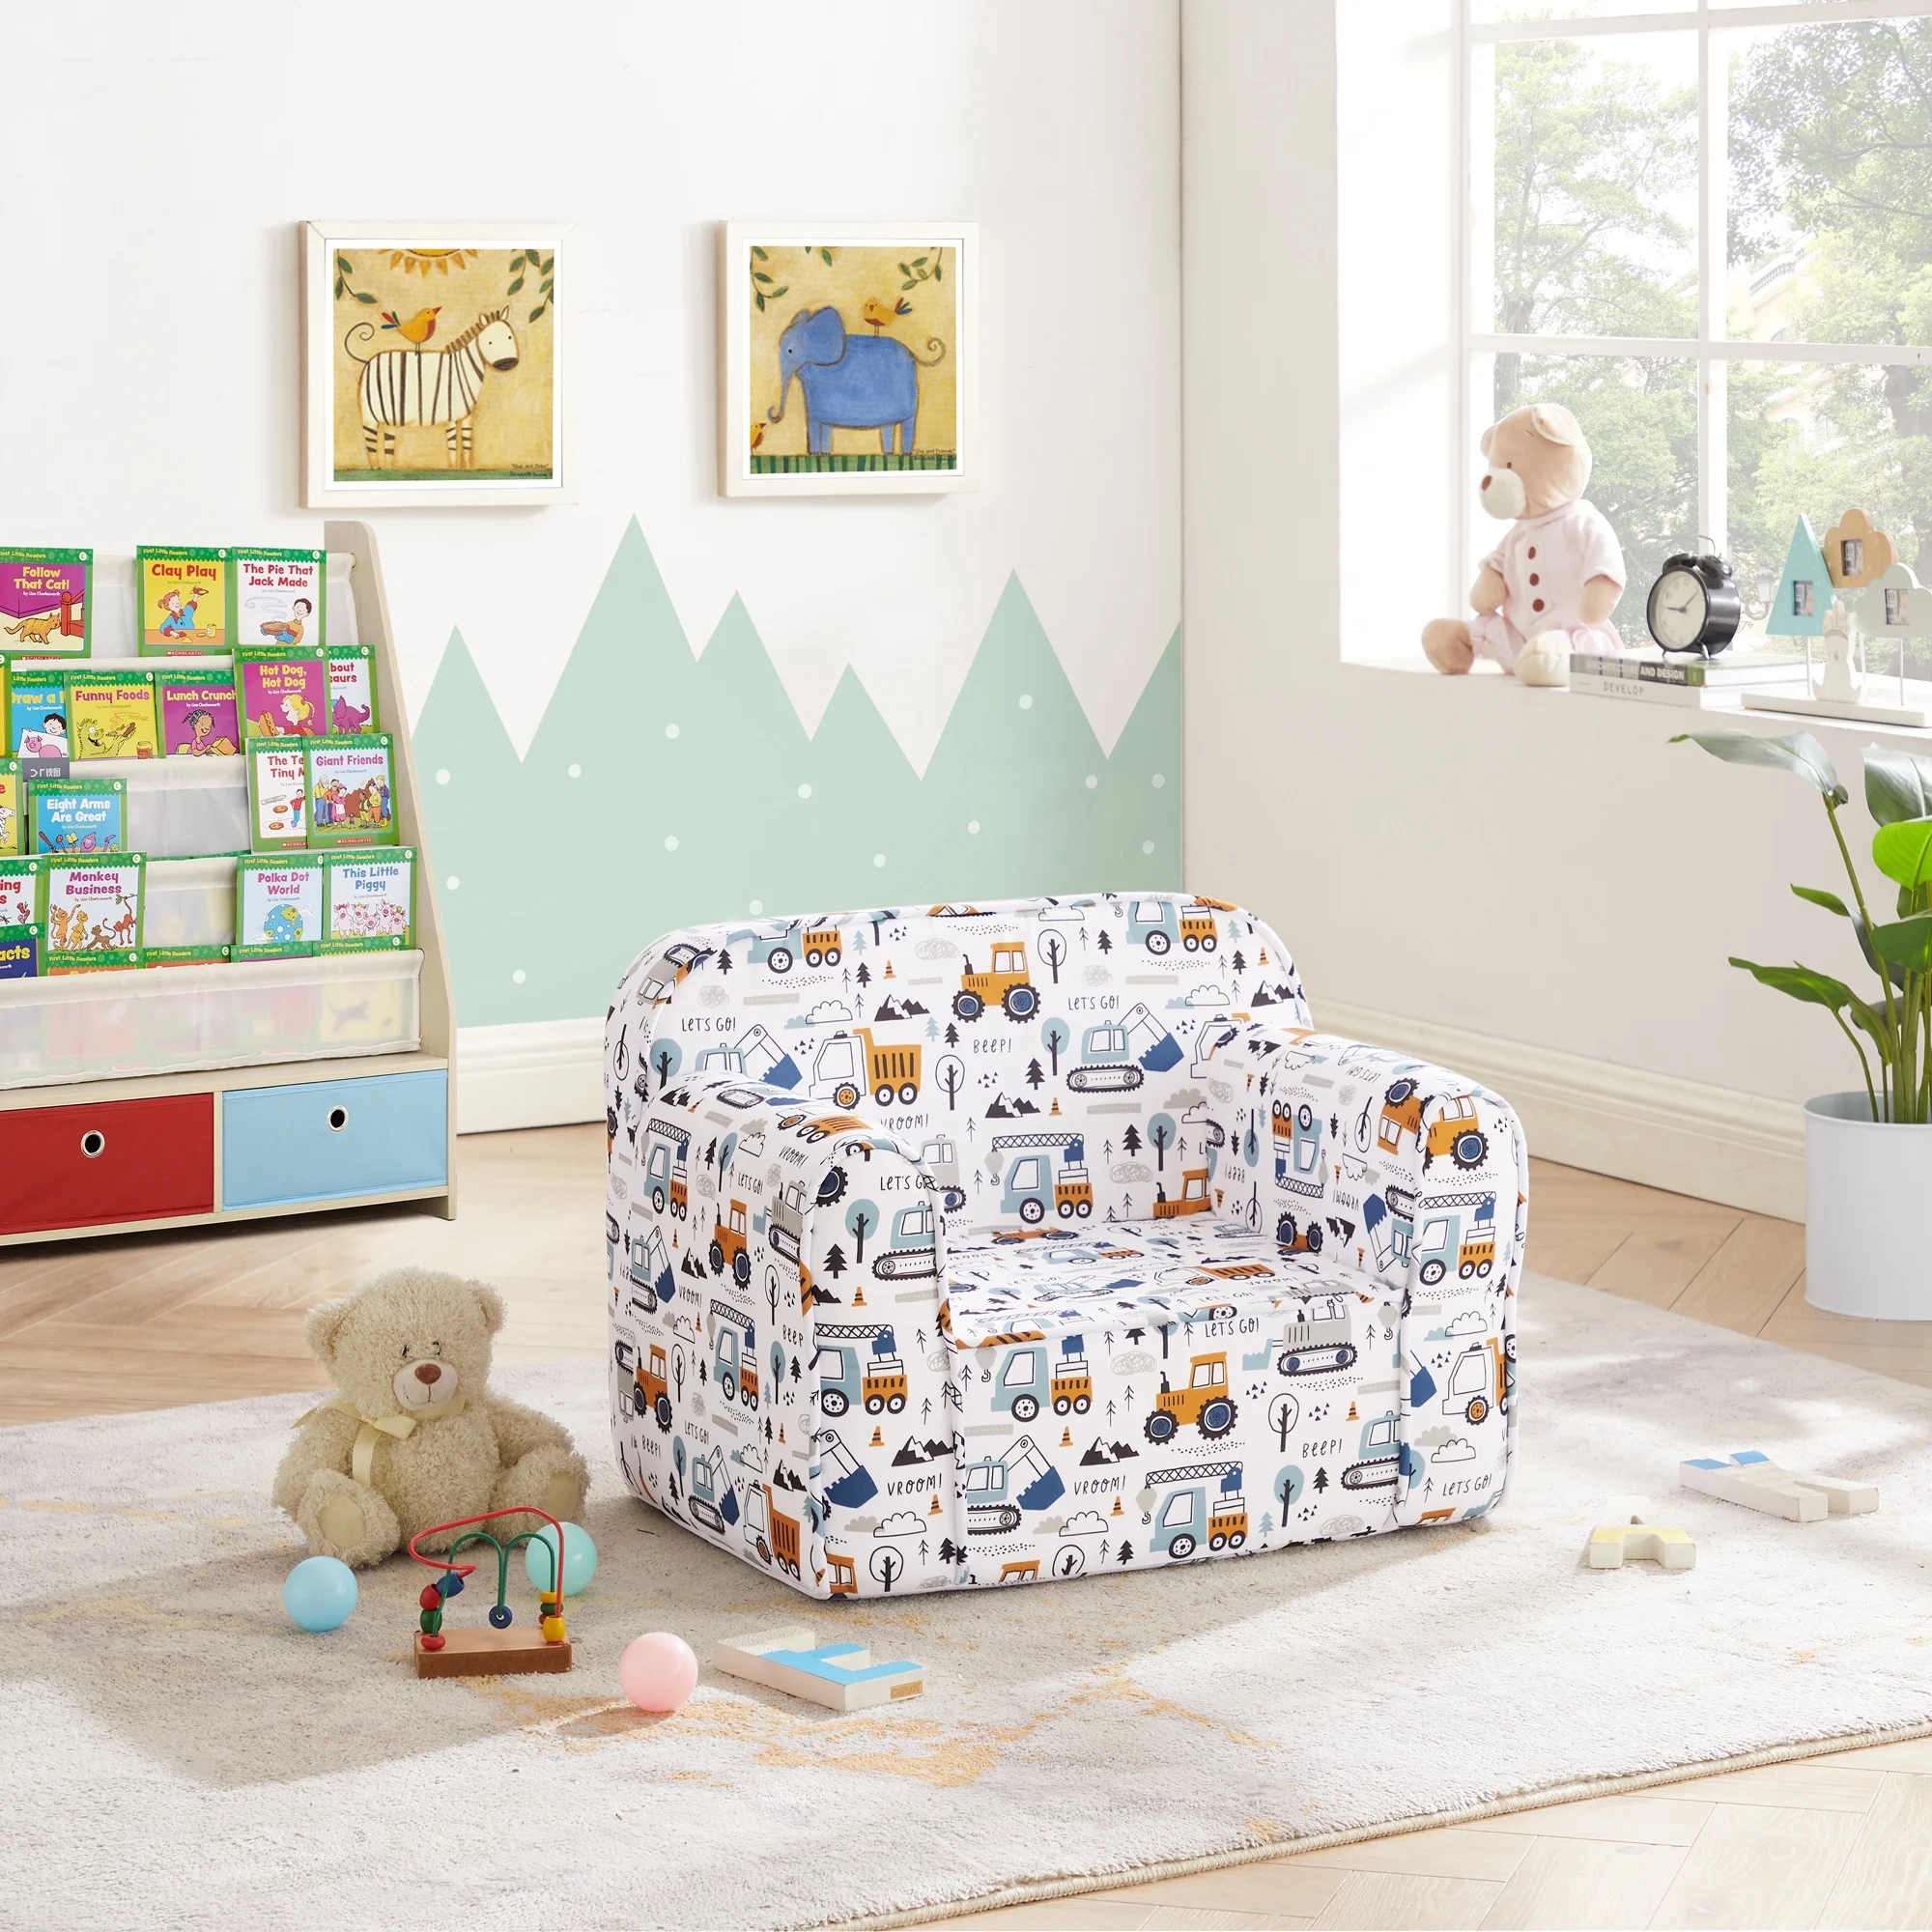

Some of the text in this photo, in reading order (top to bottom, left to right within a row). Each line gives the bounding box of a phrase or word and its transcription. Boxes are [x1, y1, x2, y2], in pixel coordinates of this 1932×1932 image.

[23, 567, 61, 577] Follow
[152, 564, 216, 581] Clay Play
[243, 563, 313, 575] The Pie That
[14, 578, 70, 590] That Cat!
[249, 576, 308, 587] Jack Made
[260, 665, 306, 676] Hot Dog,
[330, 662, 354, 672] bout
[1640, 666, 1656, 677] AND
[1657, 668, 1685, 680] DESIGN
[262, 677, 306, 689] Hot Dog
[1603, 682, 1645, 695] DEVELOP
[46, 693, 56, 704] a
[76, 690, 112, 704] Funny
[116, 689, 150, 700] Foods
[167, 690, 199, 701] Lunch
[268, 756, 287, 765] The
[316, 754, 383, 766] Giant Friends
[270, 768, 295, 780] Tiny
[47, 799, 110, 812] Eight Arms
[51, 811, 107, 822] Are Great
[69, 871, 119, 883] Monkey
[258, 872, 310, 882] Polka Dot
[343, 867, 399, 878] This Little
[66, 884, 122, 895] Business
[268, 884, 300, 895] World
[355, 880, 385, 892] Piggy
[1100, 995, 1120, 1010] GO!
[716, 1017, 736, 1032] GO!
[779, 1145, 810, 1168] VROOM!
[678, 1285, 702, 1308] VROOM!
[1239, 1318, 1259, 1335] GO!
[888, 1473, 943, 1496] VROOM!
[1074, 1475, 1126, 1495] VROOM!
[1474, 1473, 1492, 1491] GO!
